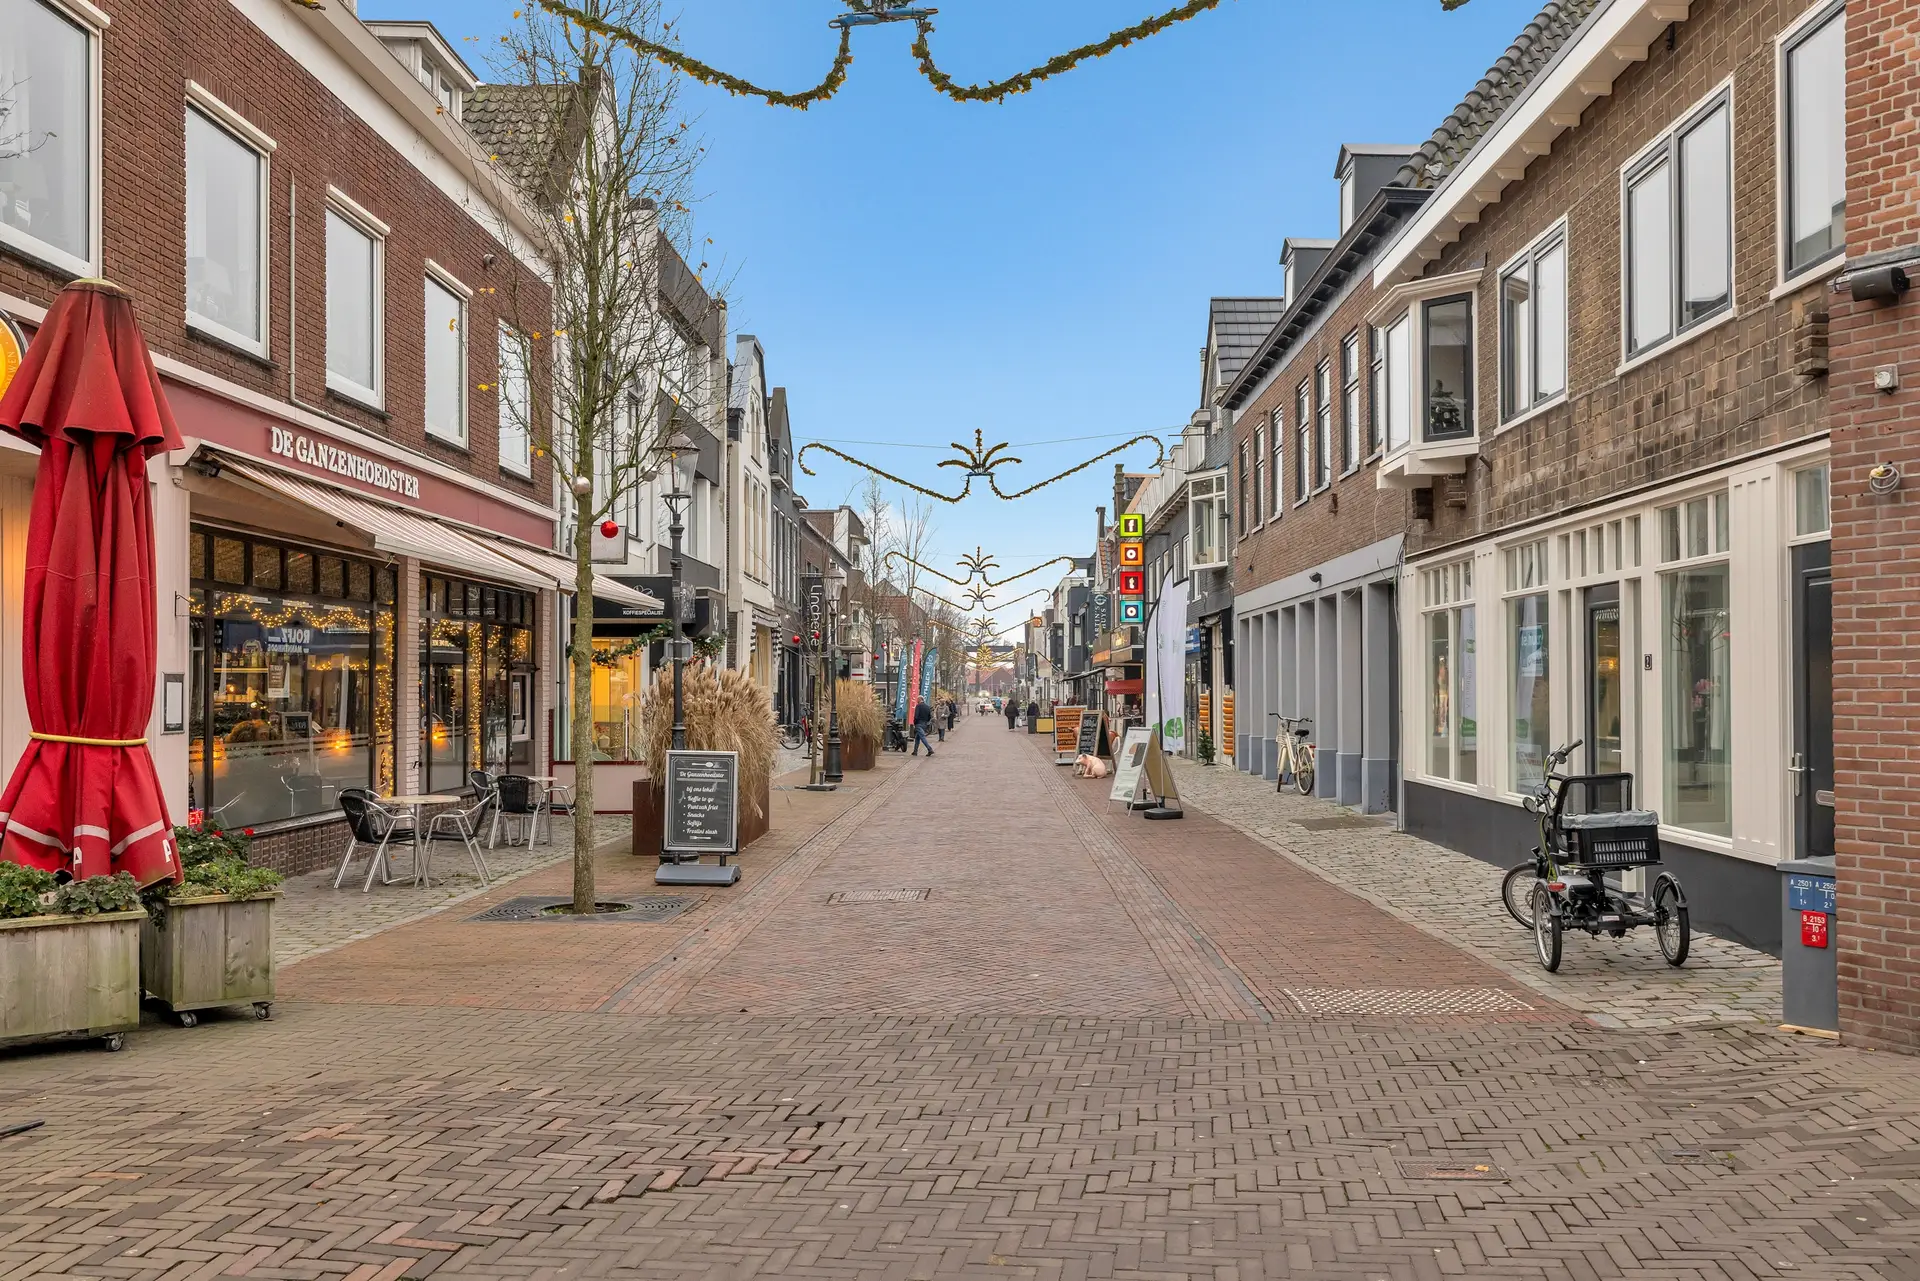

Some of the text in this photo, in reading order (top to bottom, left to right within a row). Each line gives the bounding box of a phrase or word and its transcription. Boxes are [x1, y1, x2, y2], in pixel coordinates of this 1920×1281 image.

[271, 426, 420, 499] DE GANZENHOEDSTER
[1797, 879, 1812, 887] 2501
[1810, 915, 1825, 925] 2153
